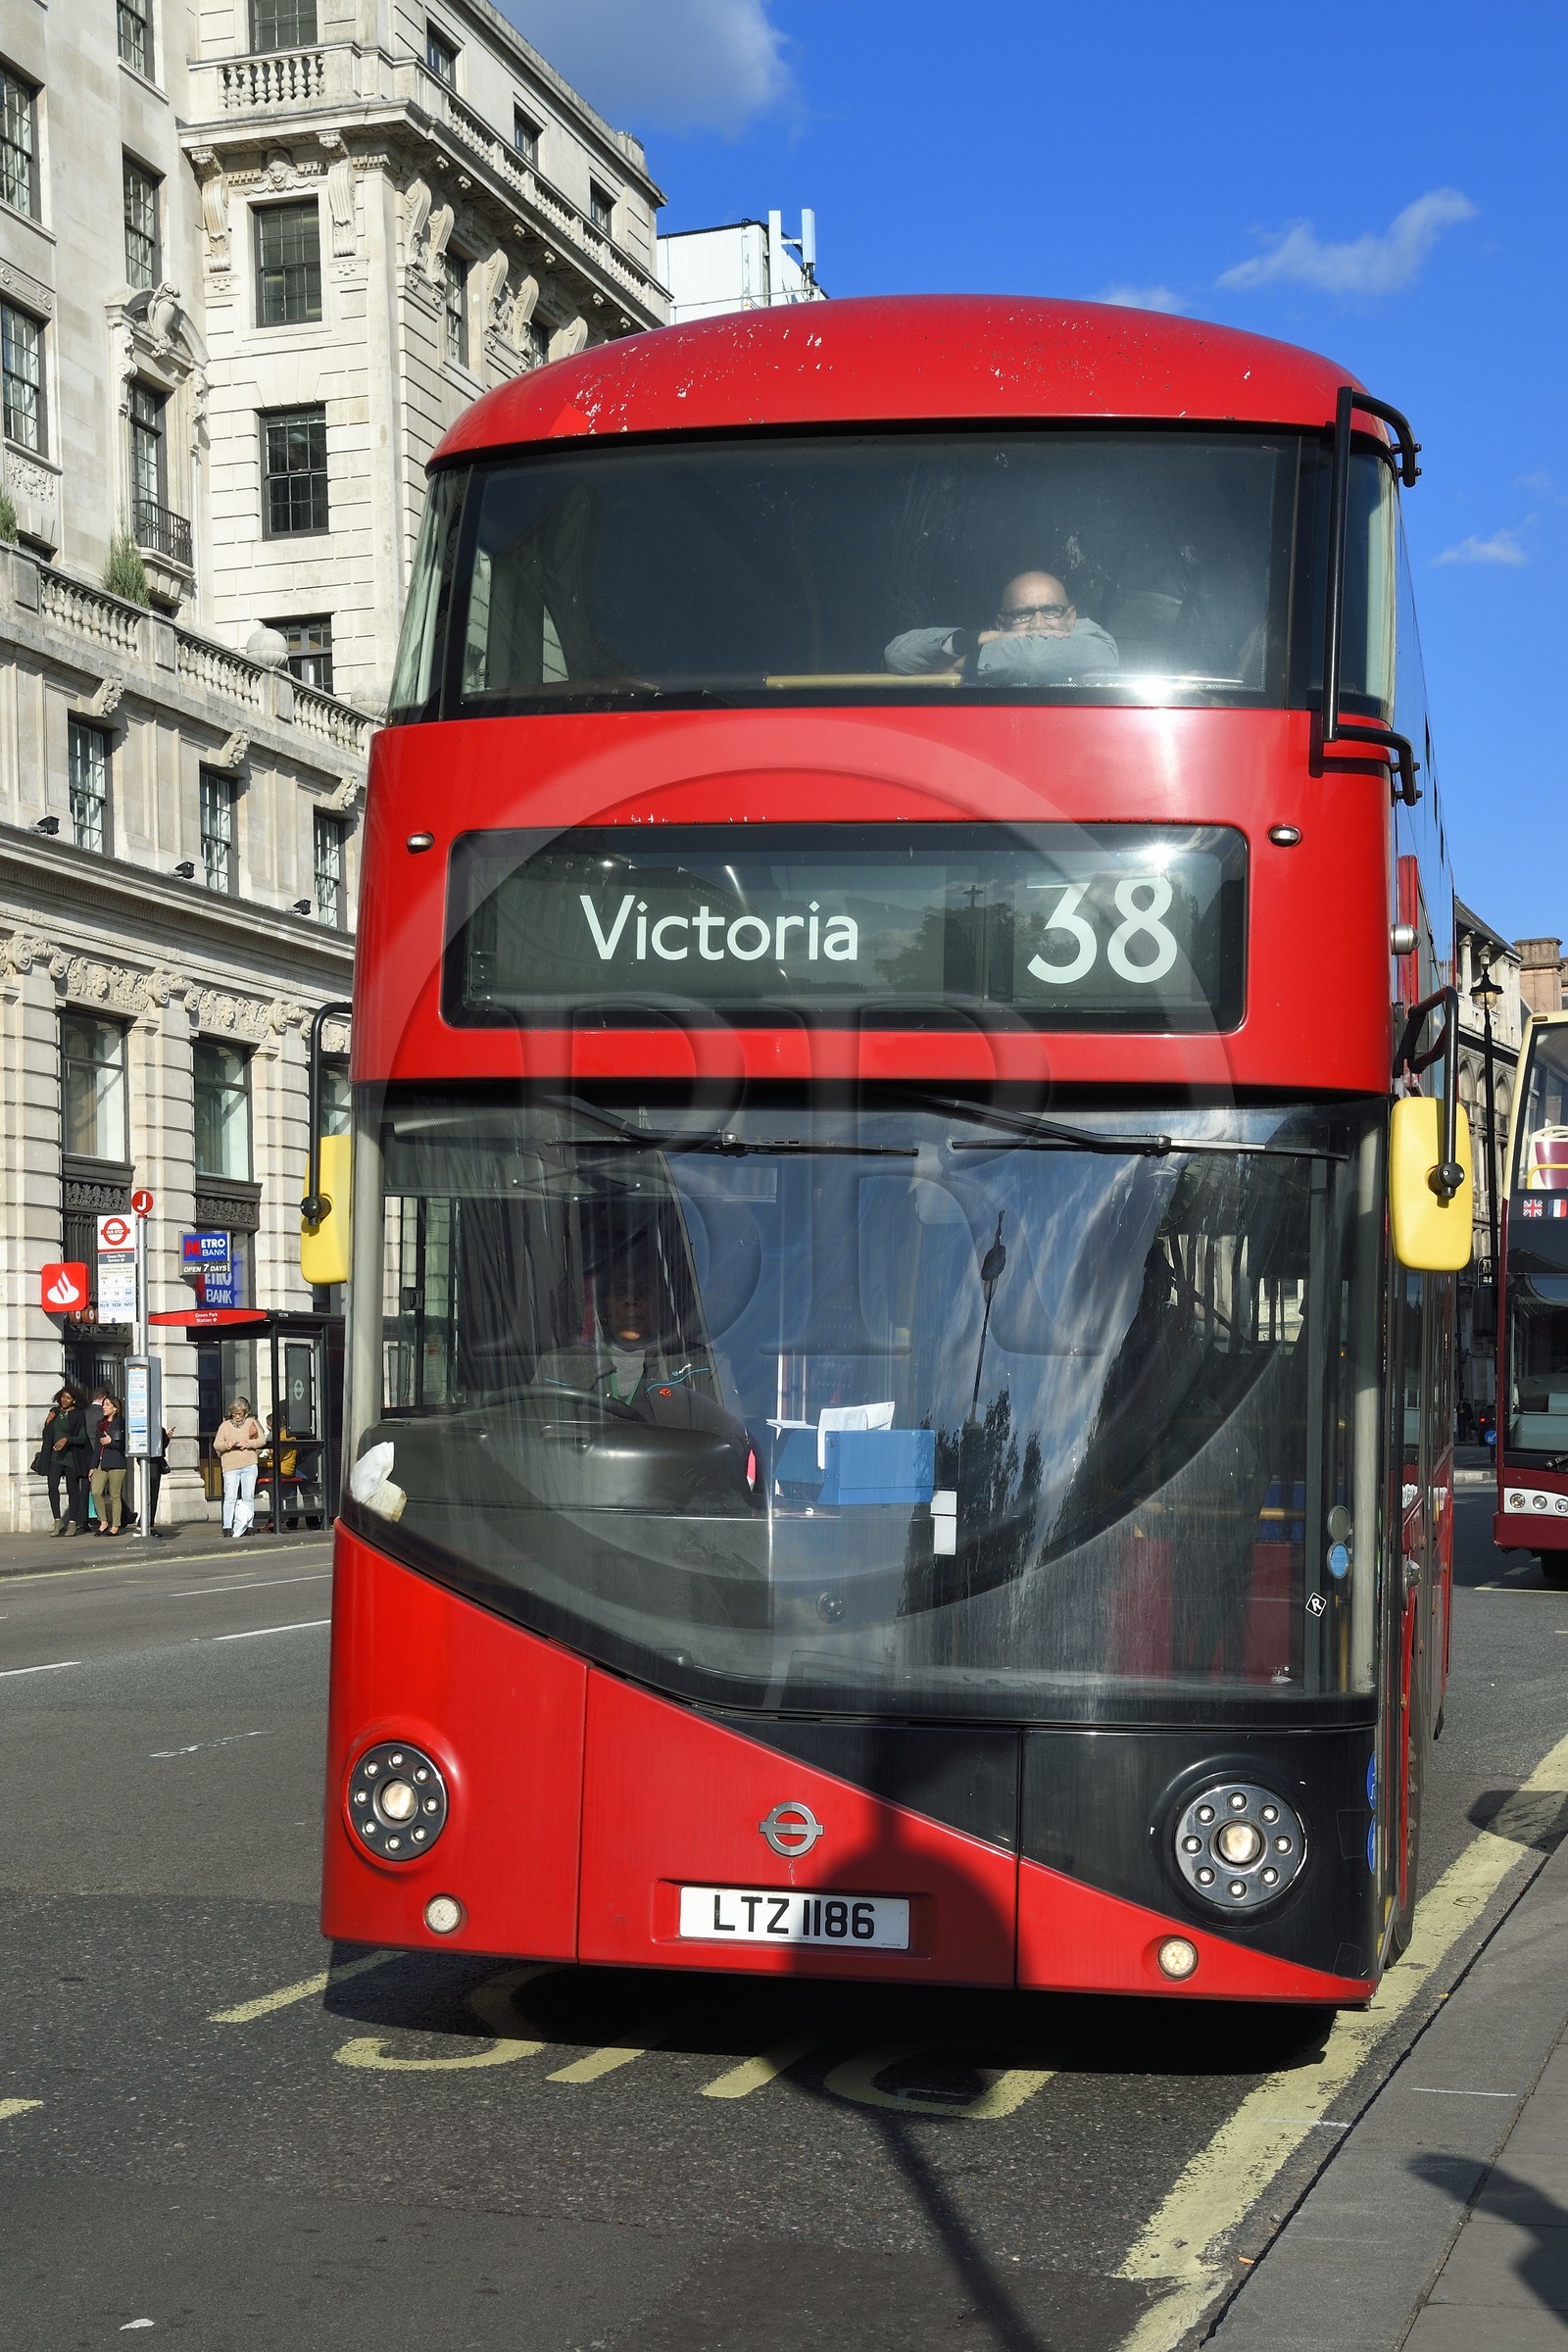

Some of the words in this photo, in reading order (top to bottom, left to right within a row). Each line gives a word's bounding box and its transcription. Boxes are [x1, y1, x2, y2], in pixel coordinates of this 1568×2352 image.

[579, 894, 859, 962] Victoria
[1026, 875, 1178, 985] 38
[137, 1194, 147, 1211] J
[185, 1239, 225, 1256] METRO
[203, 1263, 209, 1272] 7
[206, 1289, 232, 1304] BANK
[713, 1894, 790, 1935] LTZ
[802, 1899, 875, 1939] 1186
